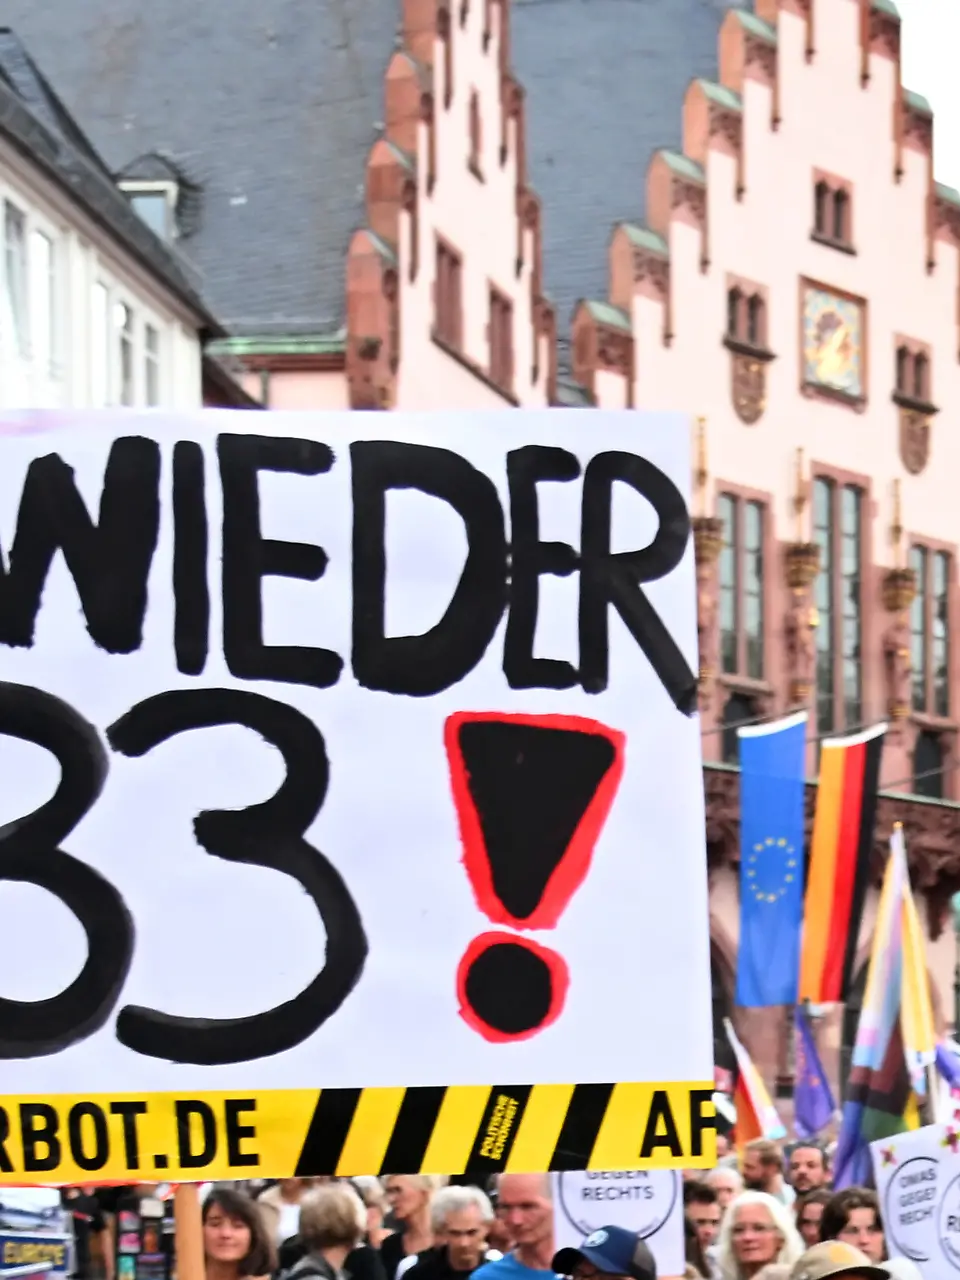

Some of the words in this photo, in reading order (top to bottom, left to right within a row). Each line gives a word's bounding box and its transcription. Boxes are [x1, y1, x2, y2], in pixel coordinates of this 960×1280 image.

[0, 433, 698, 717] WIEDER
[899, 1168, 937, 1189] OMAS
[582, 1186, 655, 1201] RECHTS
